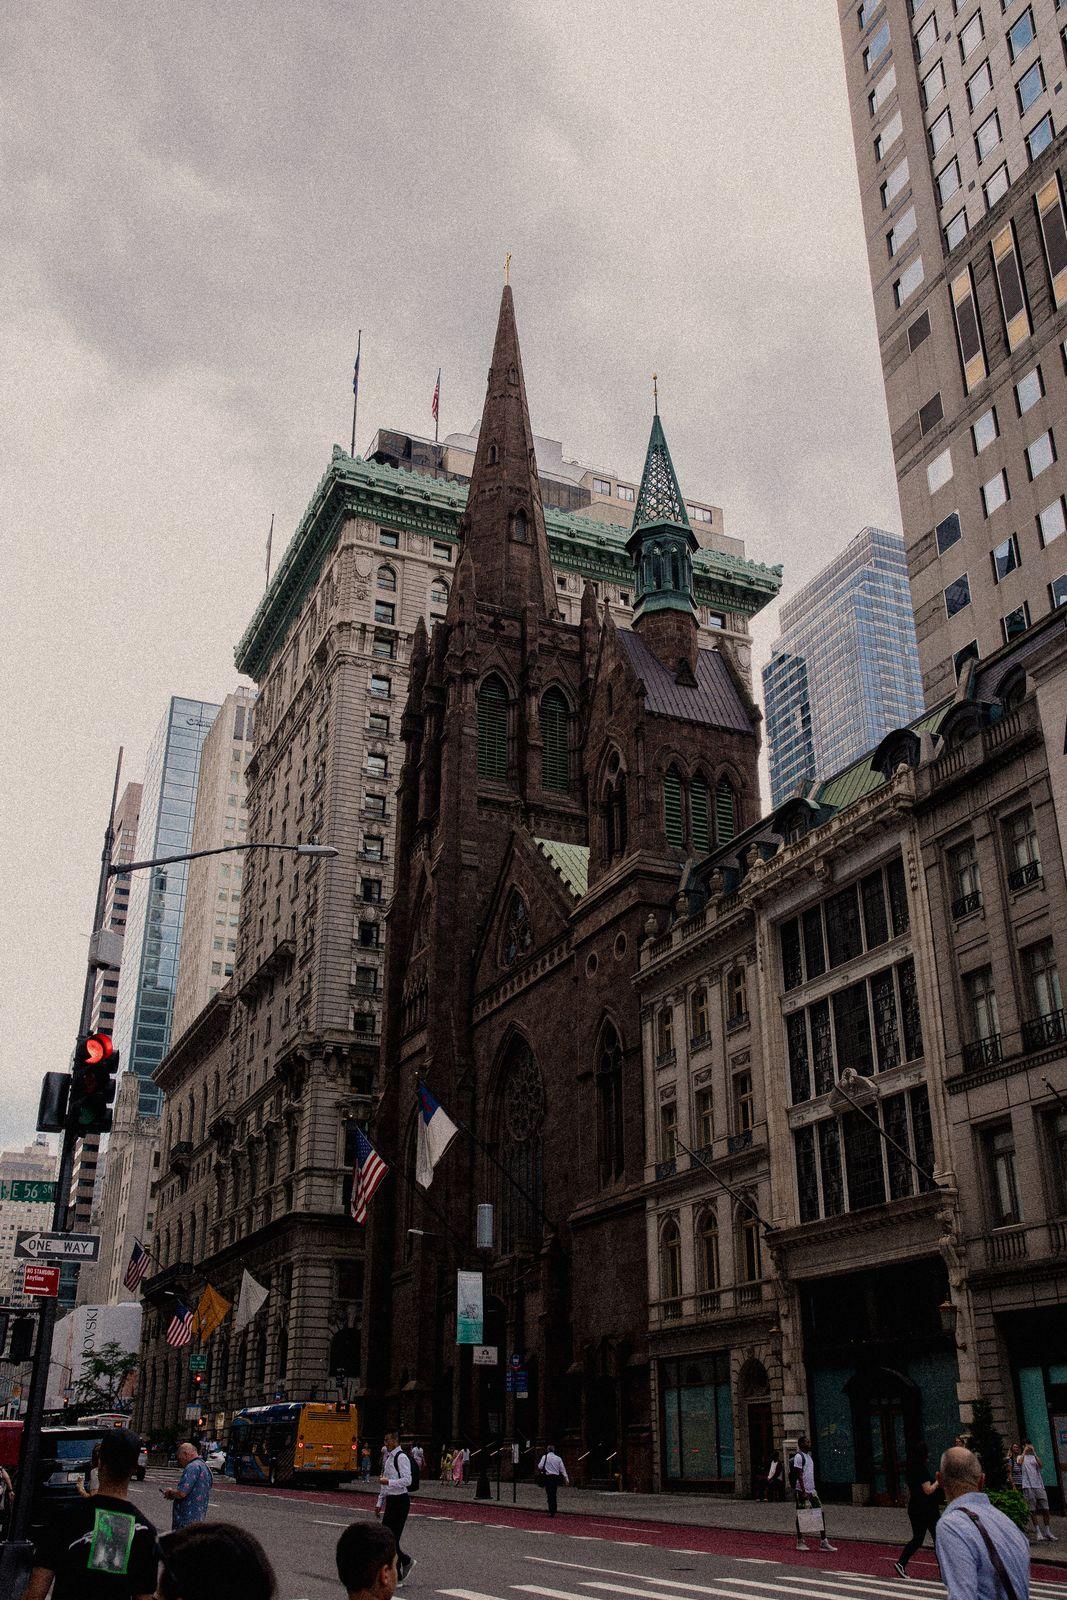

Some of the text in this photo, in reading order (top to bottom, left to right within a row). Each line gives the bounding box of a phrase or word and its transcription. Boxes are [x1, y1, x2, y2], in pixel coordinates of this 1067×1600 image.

[12, 1182, 20, 1198] E
[23, 1183, 39, 1199] 56
[28, 1240, 89, 1253] ONE WAY
[34, 1268, 55, 1276] STANDING
[26, 1274, 45, 1282] Anytime
